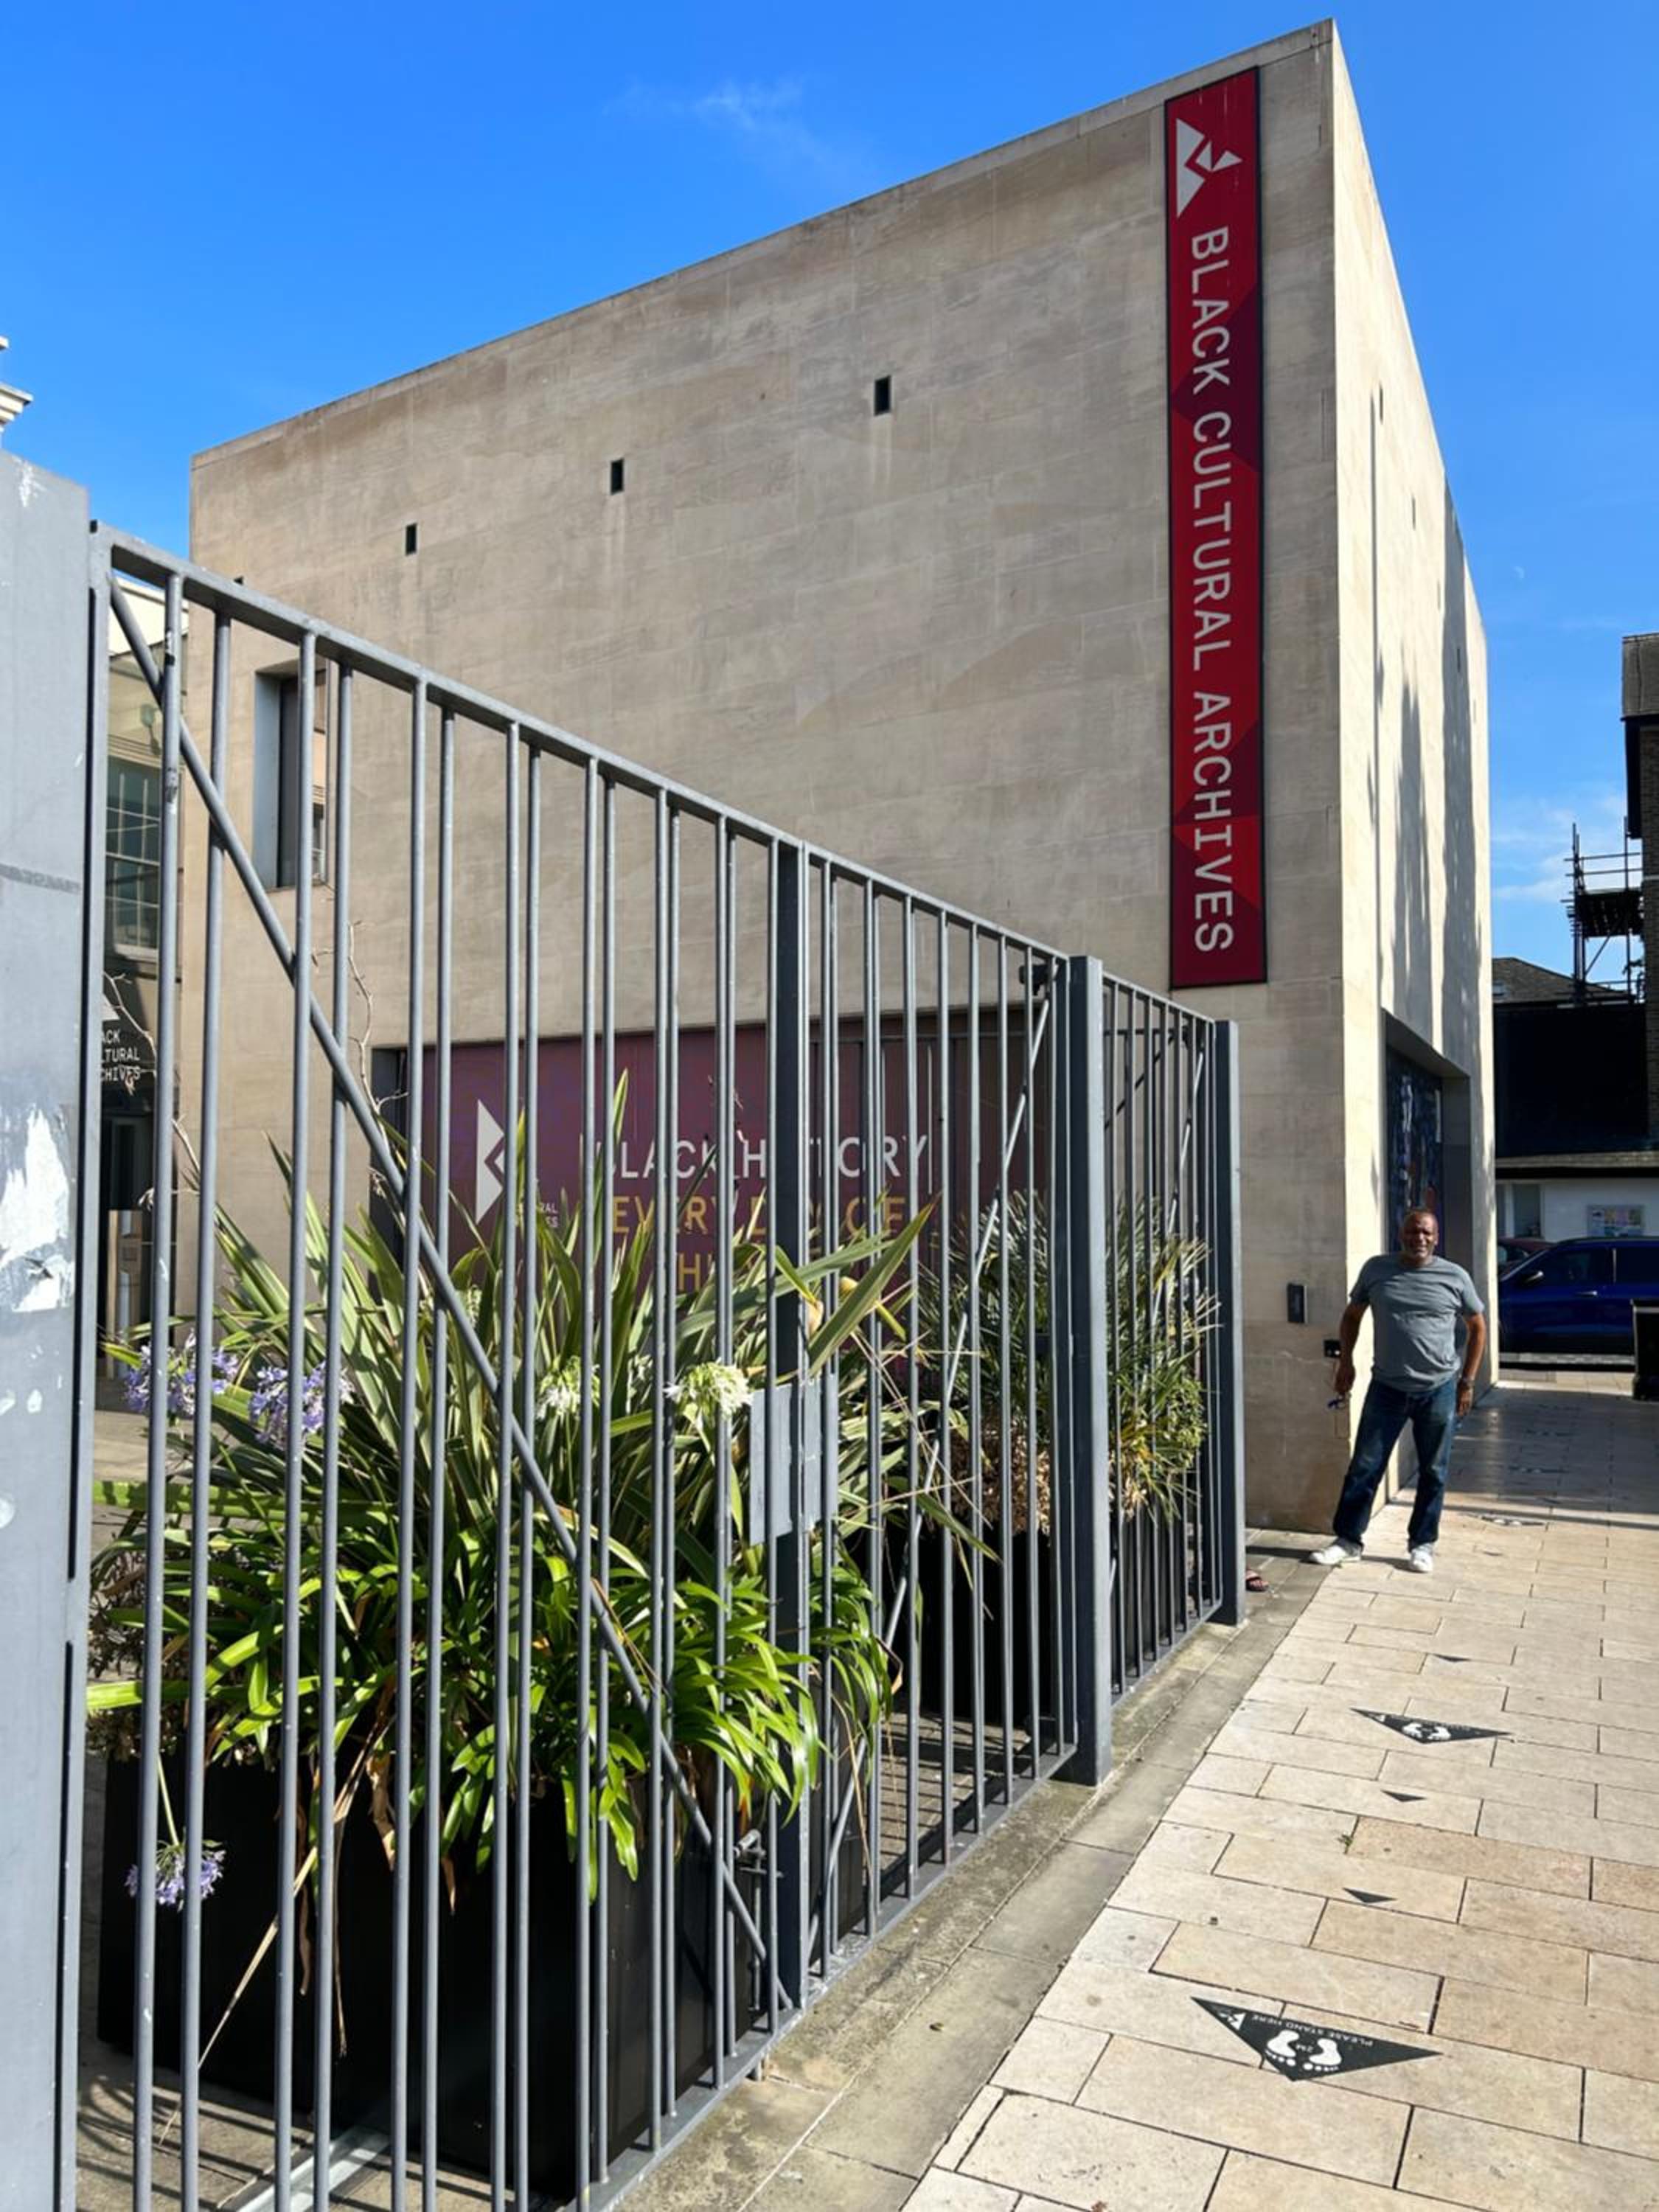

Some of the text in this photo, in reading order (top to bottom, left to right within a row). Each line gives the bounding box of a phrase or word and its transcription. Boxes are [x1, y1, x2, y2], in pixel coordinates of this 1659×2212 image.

[1192, 226, 1234, 951] BLACK CULTURAL ARCHIVES
[597, 1141, 719, 1178] LACK
